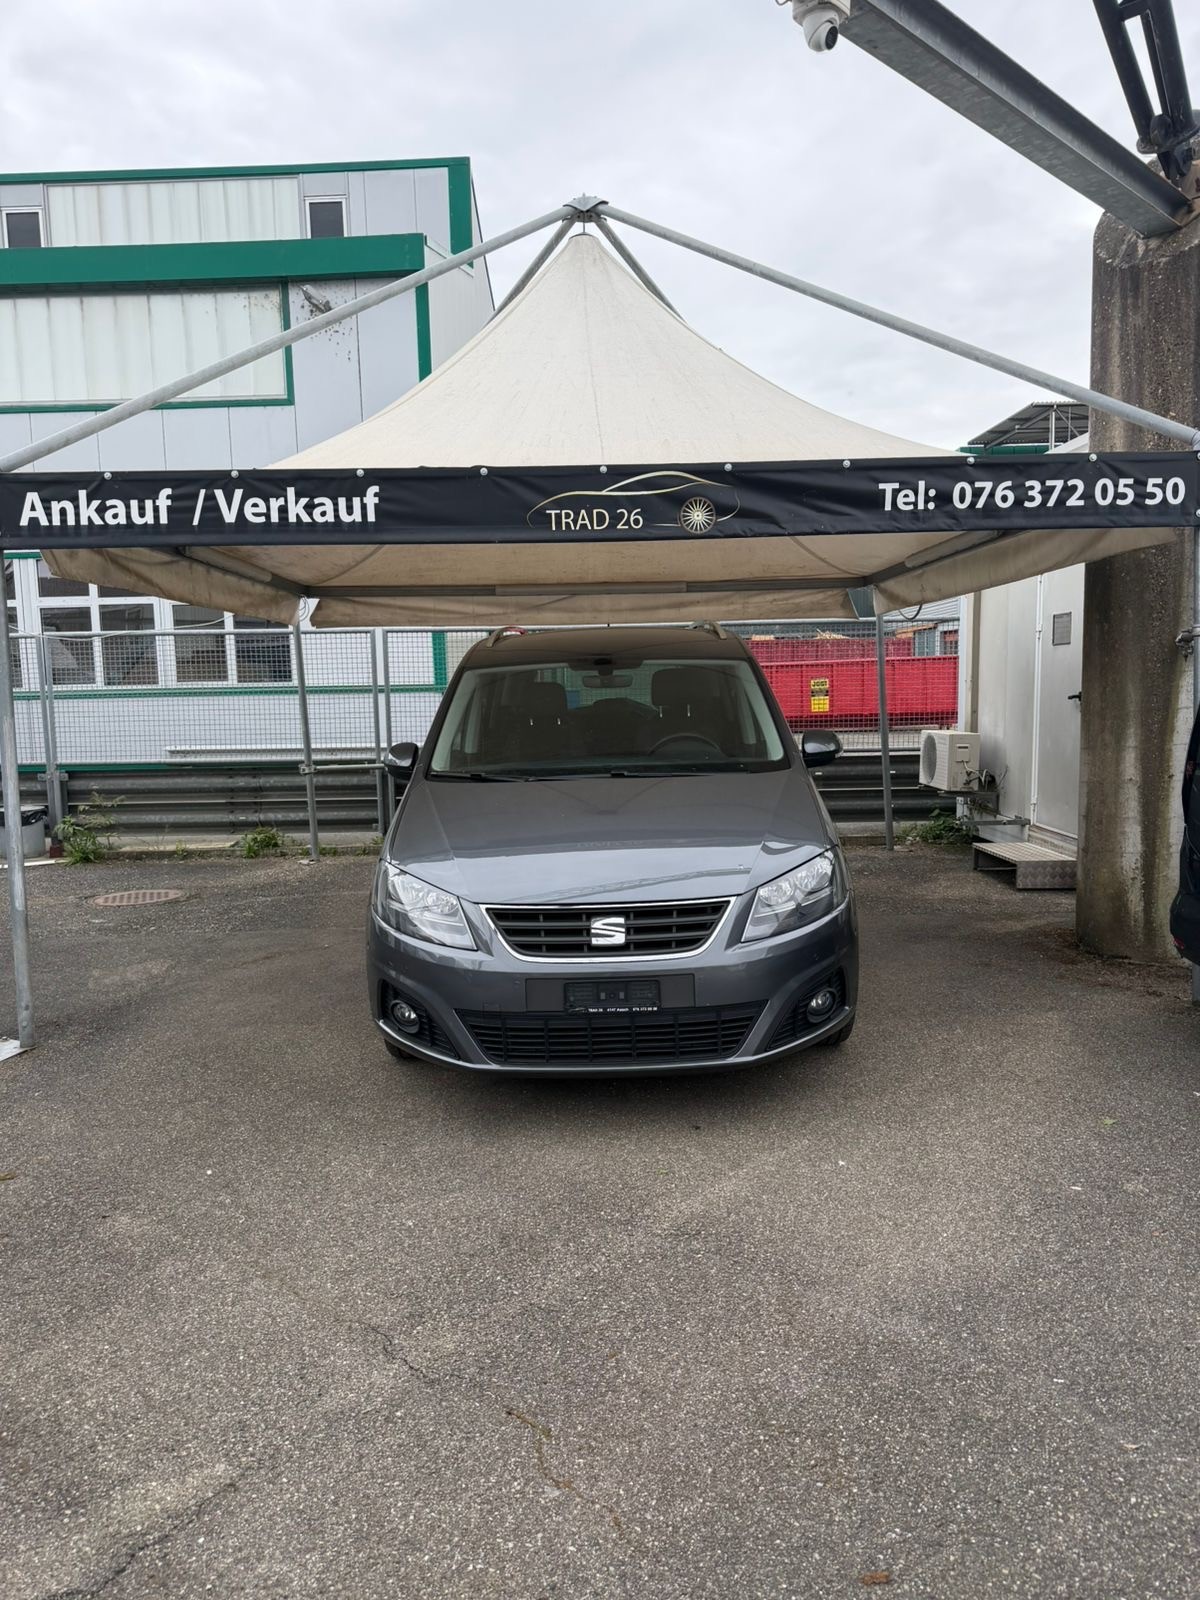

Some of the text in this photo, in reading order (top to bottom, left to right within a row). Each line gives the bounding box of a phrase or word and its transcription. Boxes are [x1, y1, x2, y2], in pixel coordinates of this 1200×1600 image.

[19, 487, 173, 527] Ankauf
[878, 476, 1186, 512] Tel: 076 372 05 50
[545, 508, 644, 531] TRAD 26
